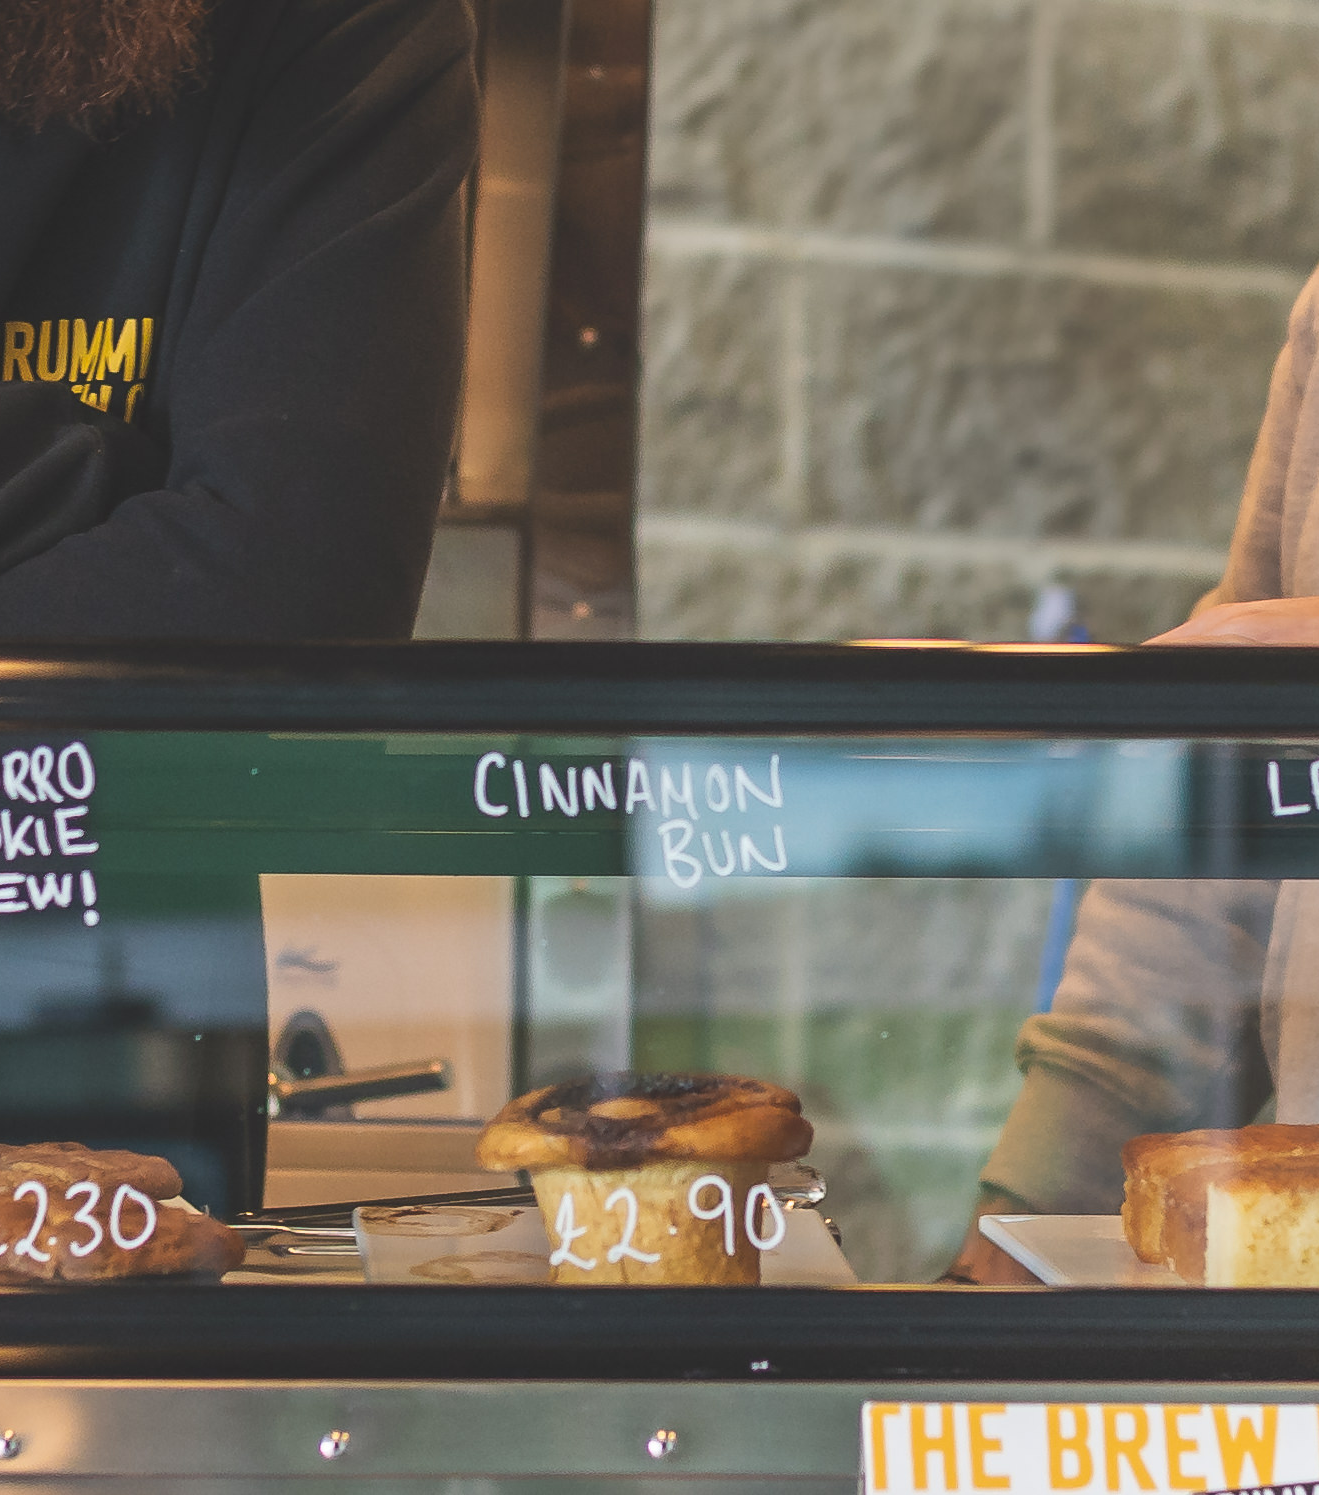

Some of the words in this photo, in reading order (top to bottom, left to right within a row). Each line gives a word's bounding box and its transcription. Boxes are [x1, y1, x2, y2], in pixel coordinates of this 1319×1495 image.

[474, 751, 784, 821] CINNAMON
[658, 818, 787, 889] BUN
[549, 1173, 786, 1271] £2.90
[870, 1402, 1011, 1491] THE
[1047, 1402, 1280, 1492] BREW
